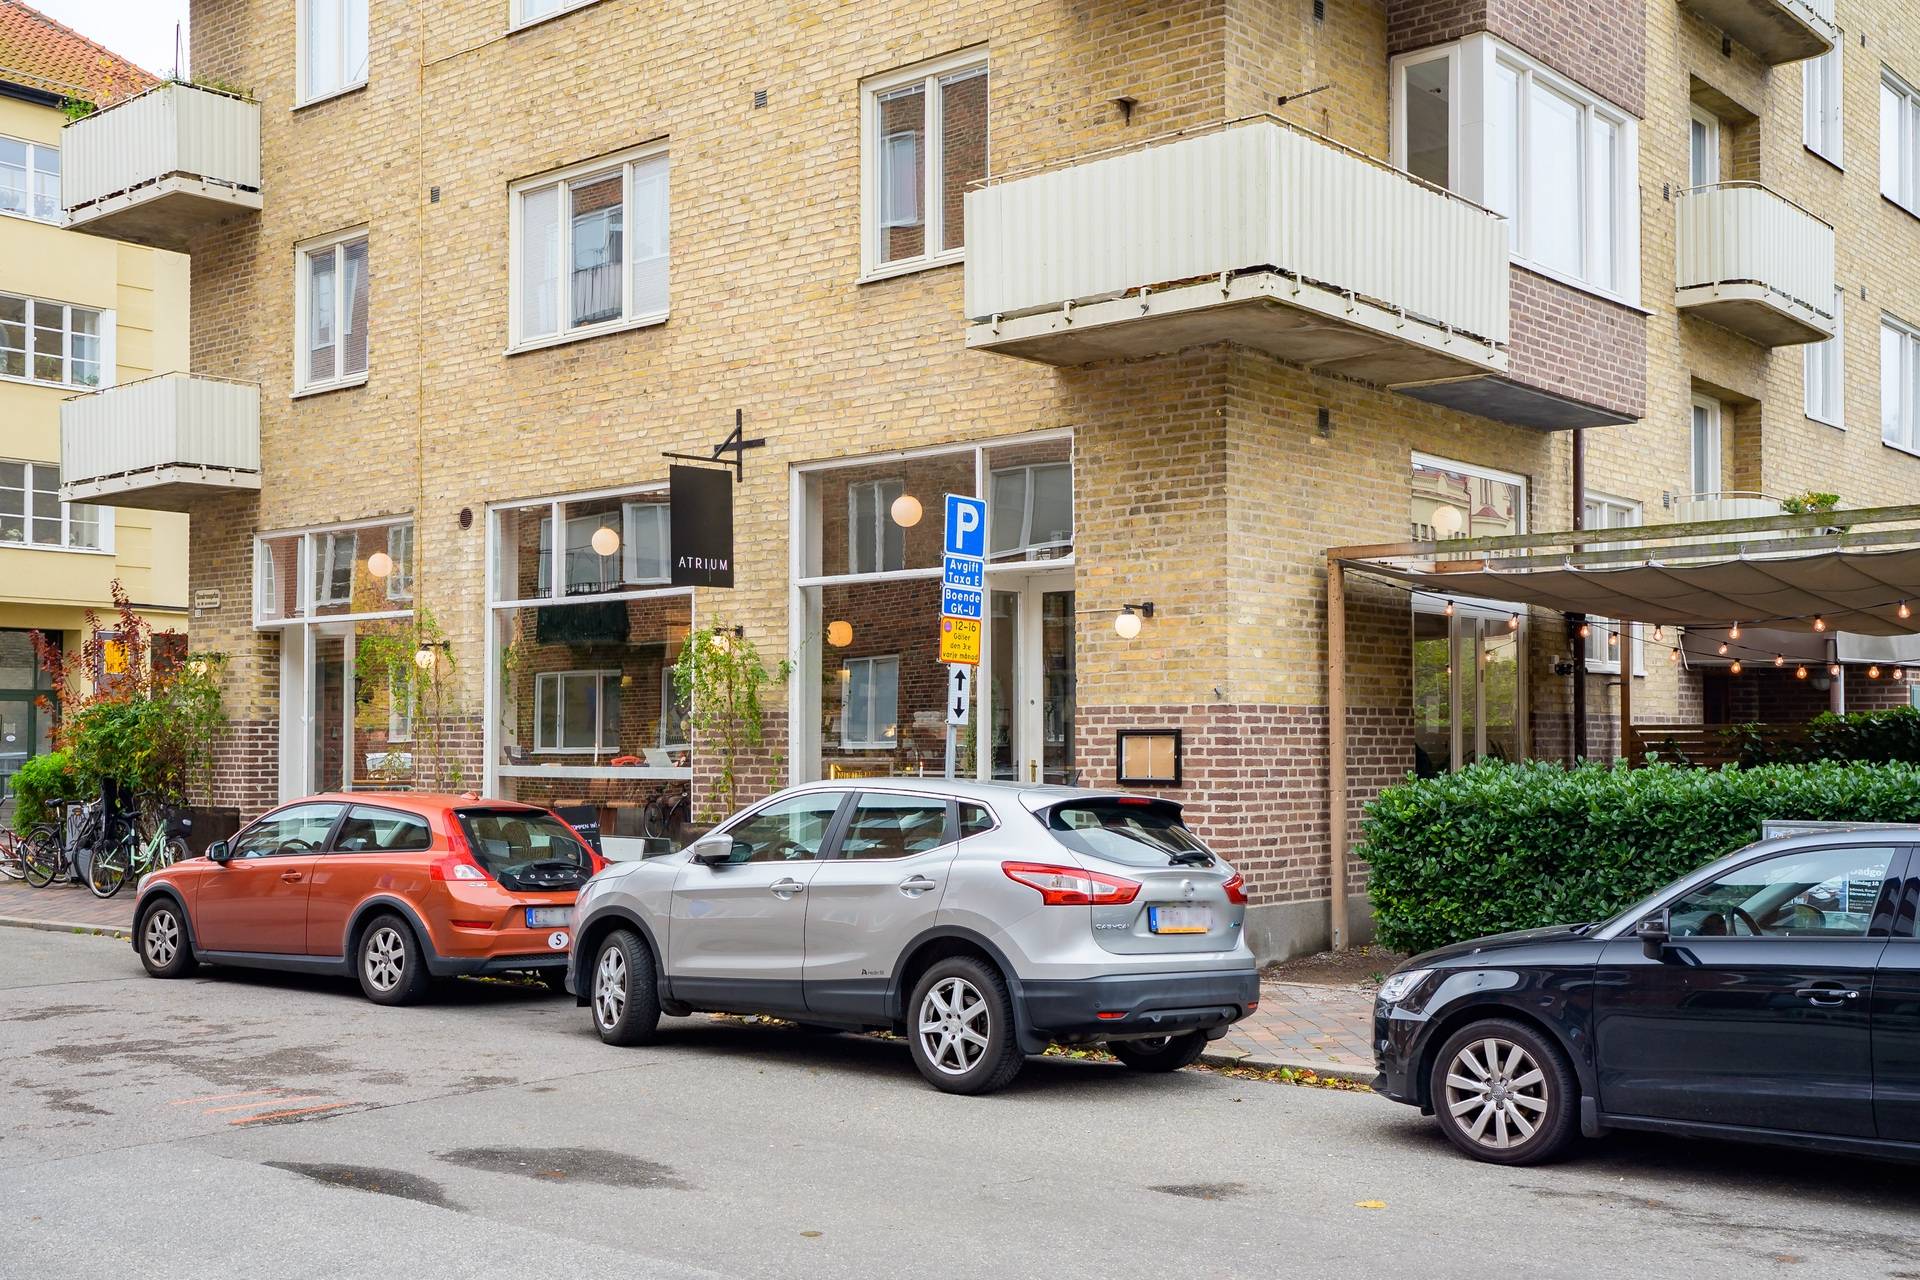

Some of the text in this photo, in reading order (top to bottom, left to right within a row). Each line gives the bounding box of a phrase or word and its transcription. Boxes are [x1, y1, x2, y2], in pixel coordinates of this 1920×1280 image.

[955, 502, 979, 549] P
[678, 556, 728, 570] ATRIUM
[950, 559, 979, 573] Avgift
[948, 572, 980, 586] Taxa E
[945, 589, 980, 603] Boende
[950, 603, 975, 615] GK-U
[955, 621, 977, 632] 12-16
[950, 642, 961, 650] den
[942, 651, 979, 661] varje månad
[555, 934, 562, 946] S
